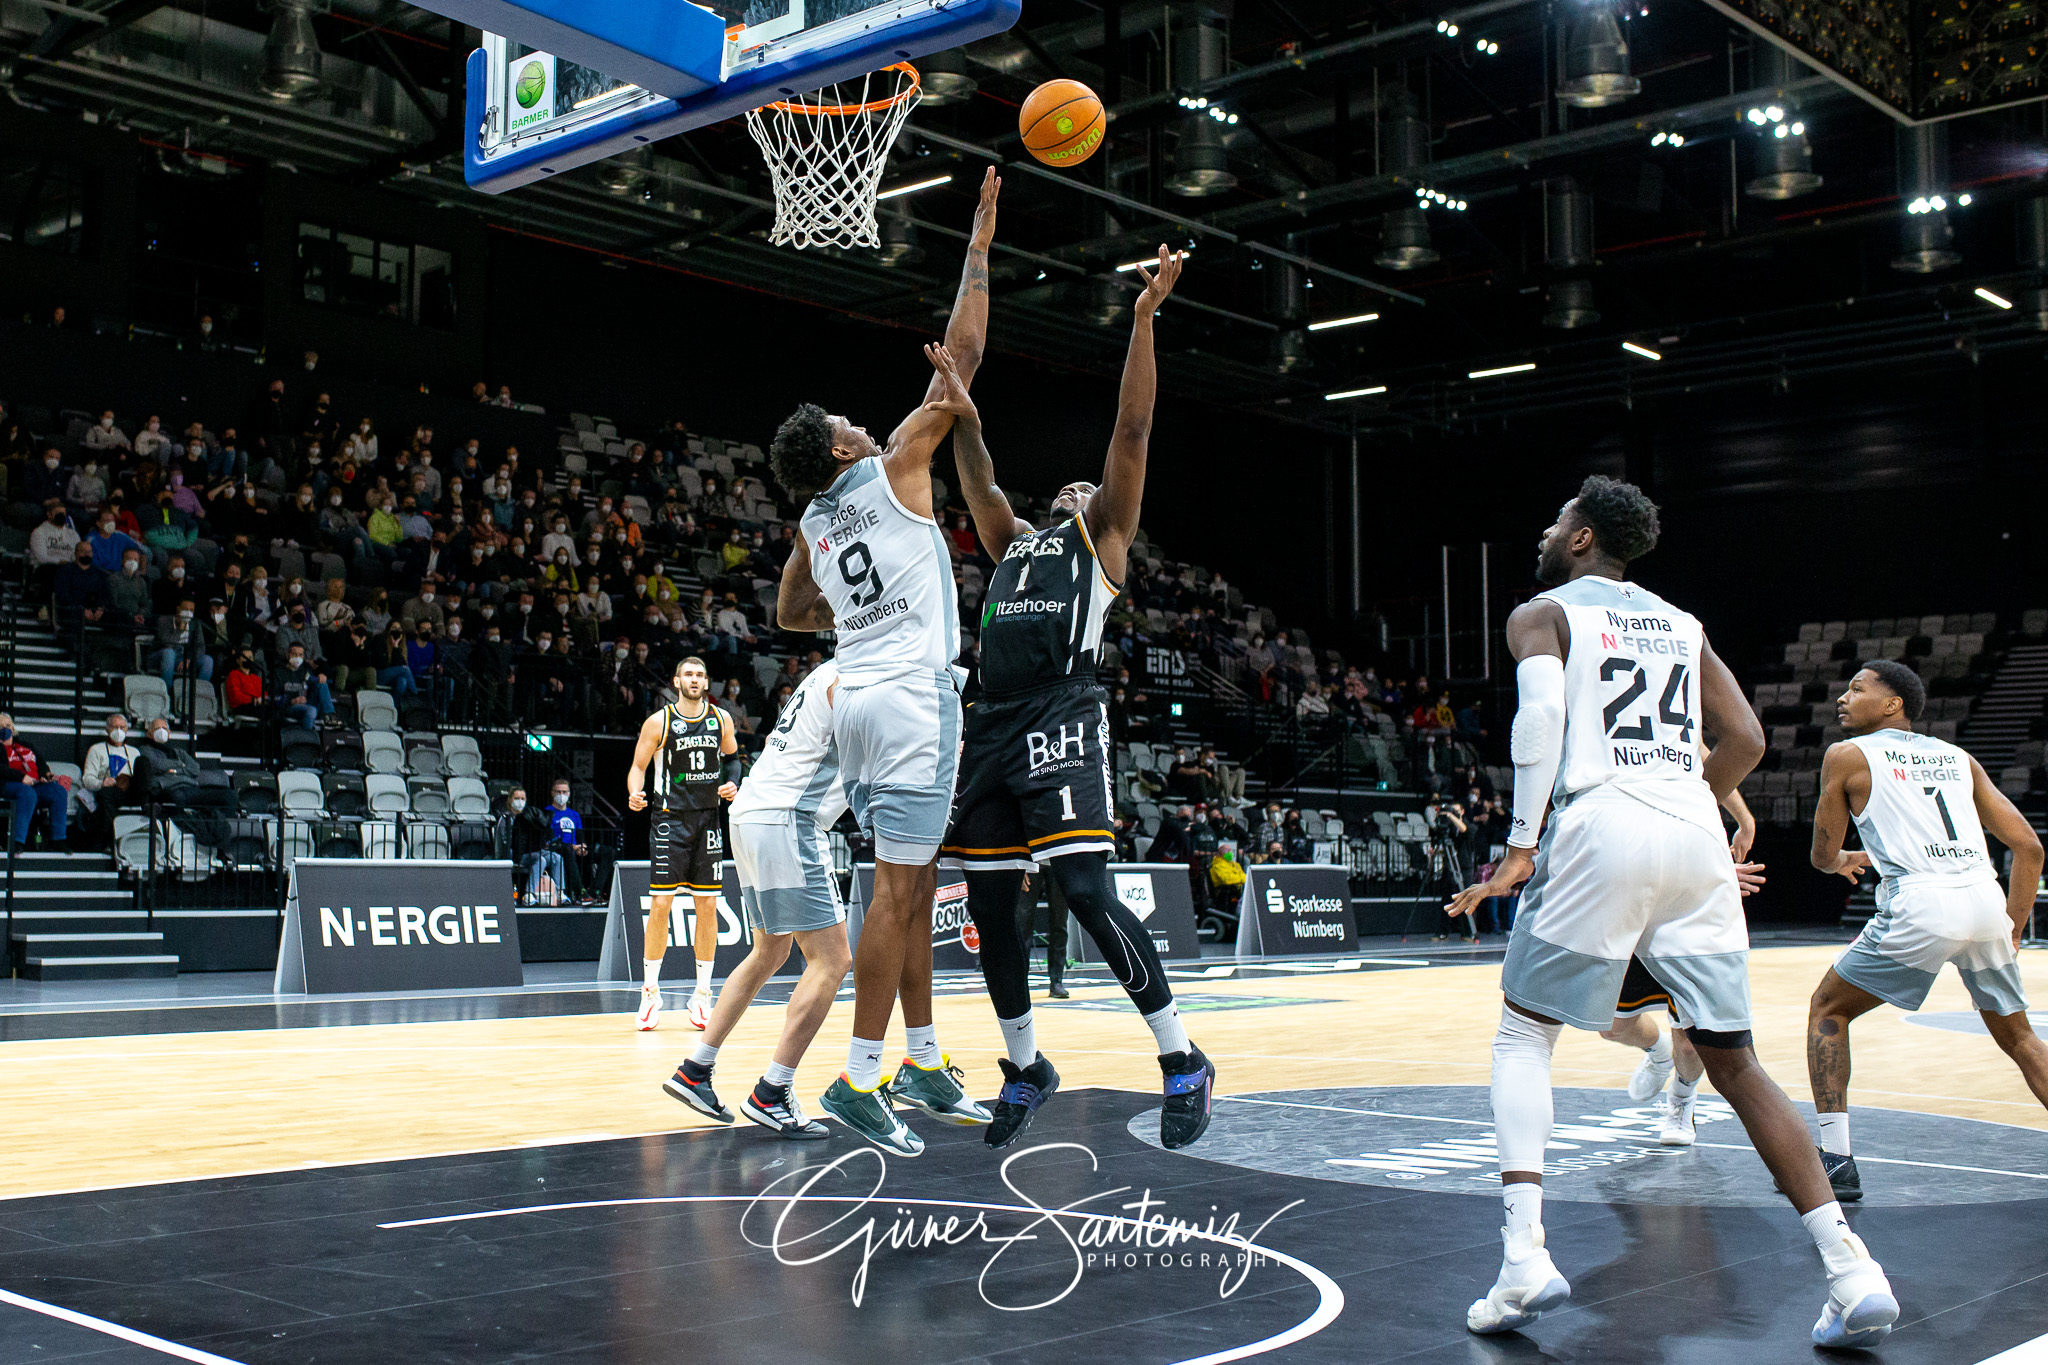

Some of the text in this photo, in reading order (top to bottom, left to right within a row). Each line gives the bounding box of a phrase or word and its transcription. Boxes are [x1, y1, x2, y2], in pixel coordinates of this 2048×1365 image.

[511, 108, 549, 130] BARMER
[1048, 127, 1101, 160] Wilson
[837, 541, 885, 609] 9
[1015, 562, 1030, 592] 1
[843, 597, 909, 632] Nürnberg
[996, 598, 1067, 617] Itzehoer
[1606, 610, 1673, 633] Nyama
[1599, 657, 1694, 744] 24
[675, 735, 719, 752] EAGLES
[1026, 722, 1085, 770] B&H
[688, 750, 706, 771] 13
[1040, 764, 1059, 776] SIND
[1059, 759, 1085, 769] MODE
[1059, 785, 1077, 821] 1
[1922, 786, 1958, 841] 1
[1288, 894, 1343, 917] Sparkasse
[1292, 919, 1345, 942] Nürnberg
